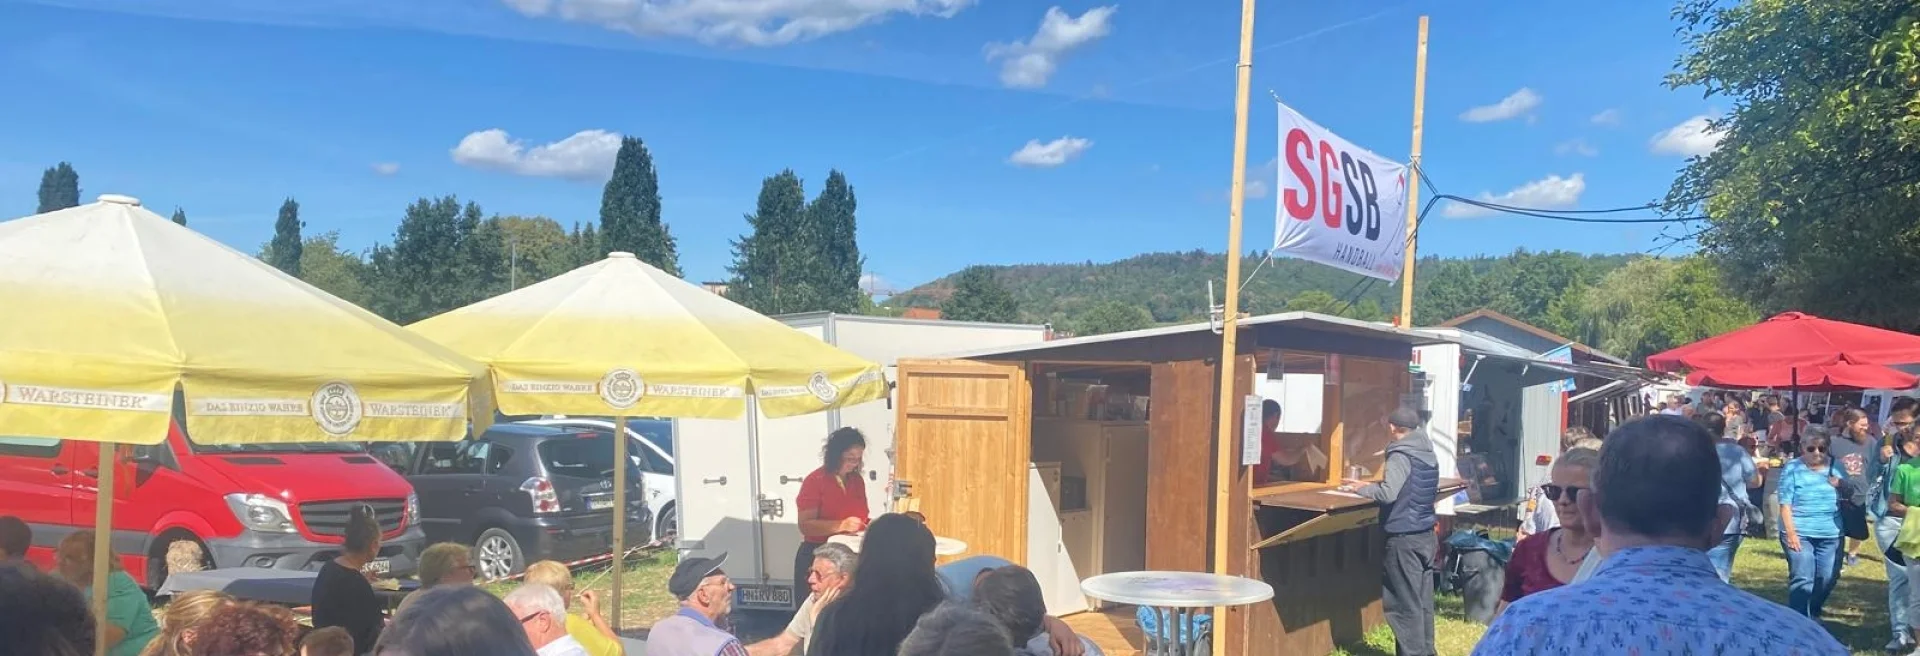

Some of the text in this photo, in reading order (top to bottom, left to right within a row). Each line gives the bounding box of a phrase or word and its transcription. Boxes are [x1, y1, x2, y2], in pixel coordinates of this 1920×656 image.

[1283, 127, 1381, 241] SGSB
[1332, 242, 1376, 271] HANDBALL
[18, 386, 142, 408] WARSTEINER
[206, 402, 227, 412] DAS
